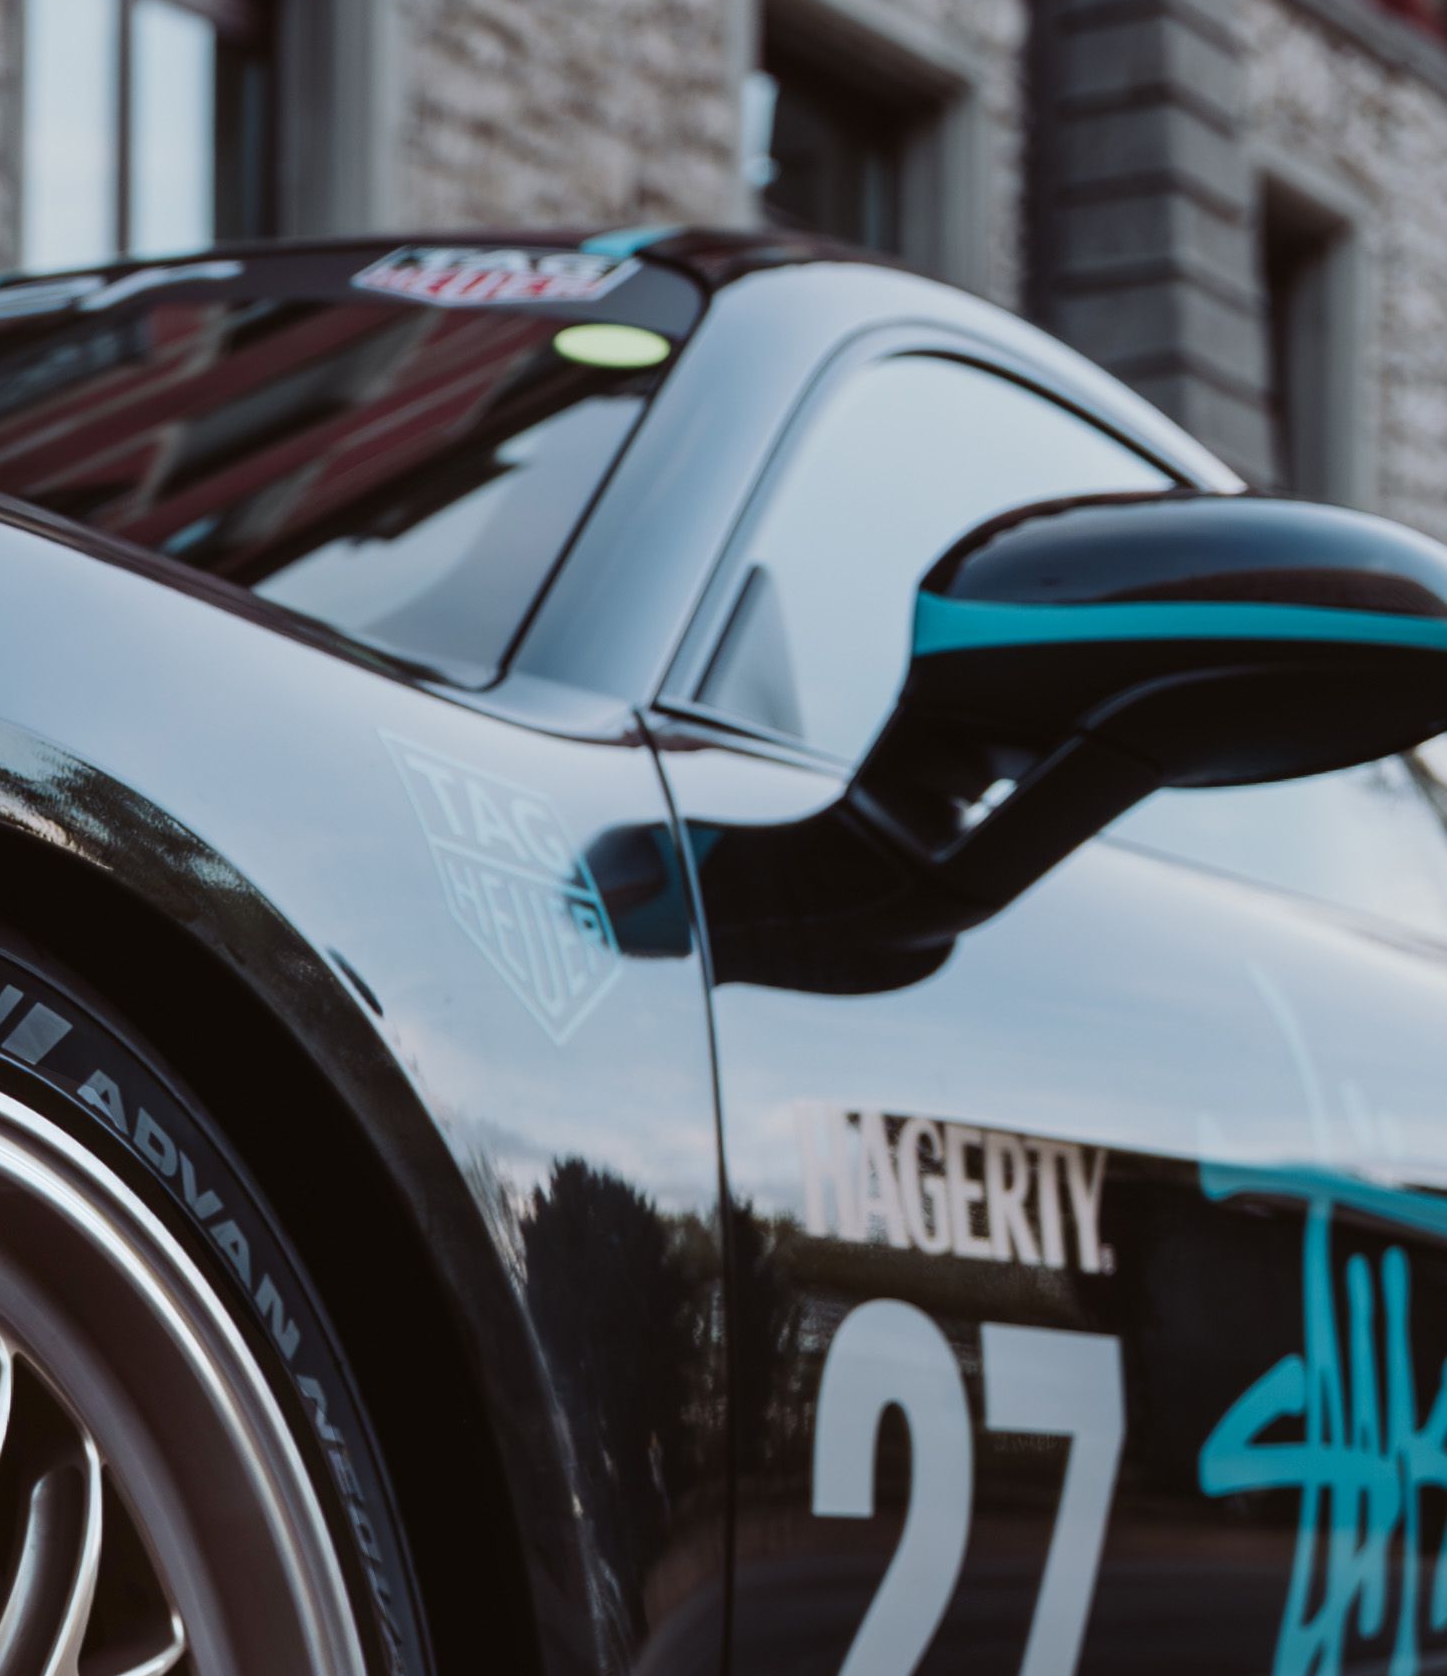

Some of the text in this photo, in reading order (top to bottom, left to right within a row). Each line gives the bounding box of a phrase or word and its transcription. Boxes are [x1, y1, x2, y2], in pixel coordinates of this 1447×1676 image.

[405, 754, 576, 880] TAG
[443, 857, 609, 1016] HEUER
[77, 1068, 303, 1362] ADVAN
[798, 1102, 1107, 1274] HAGERTY
